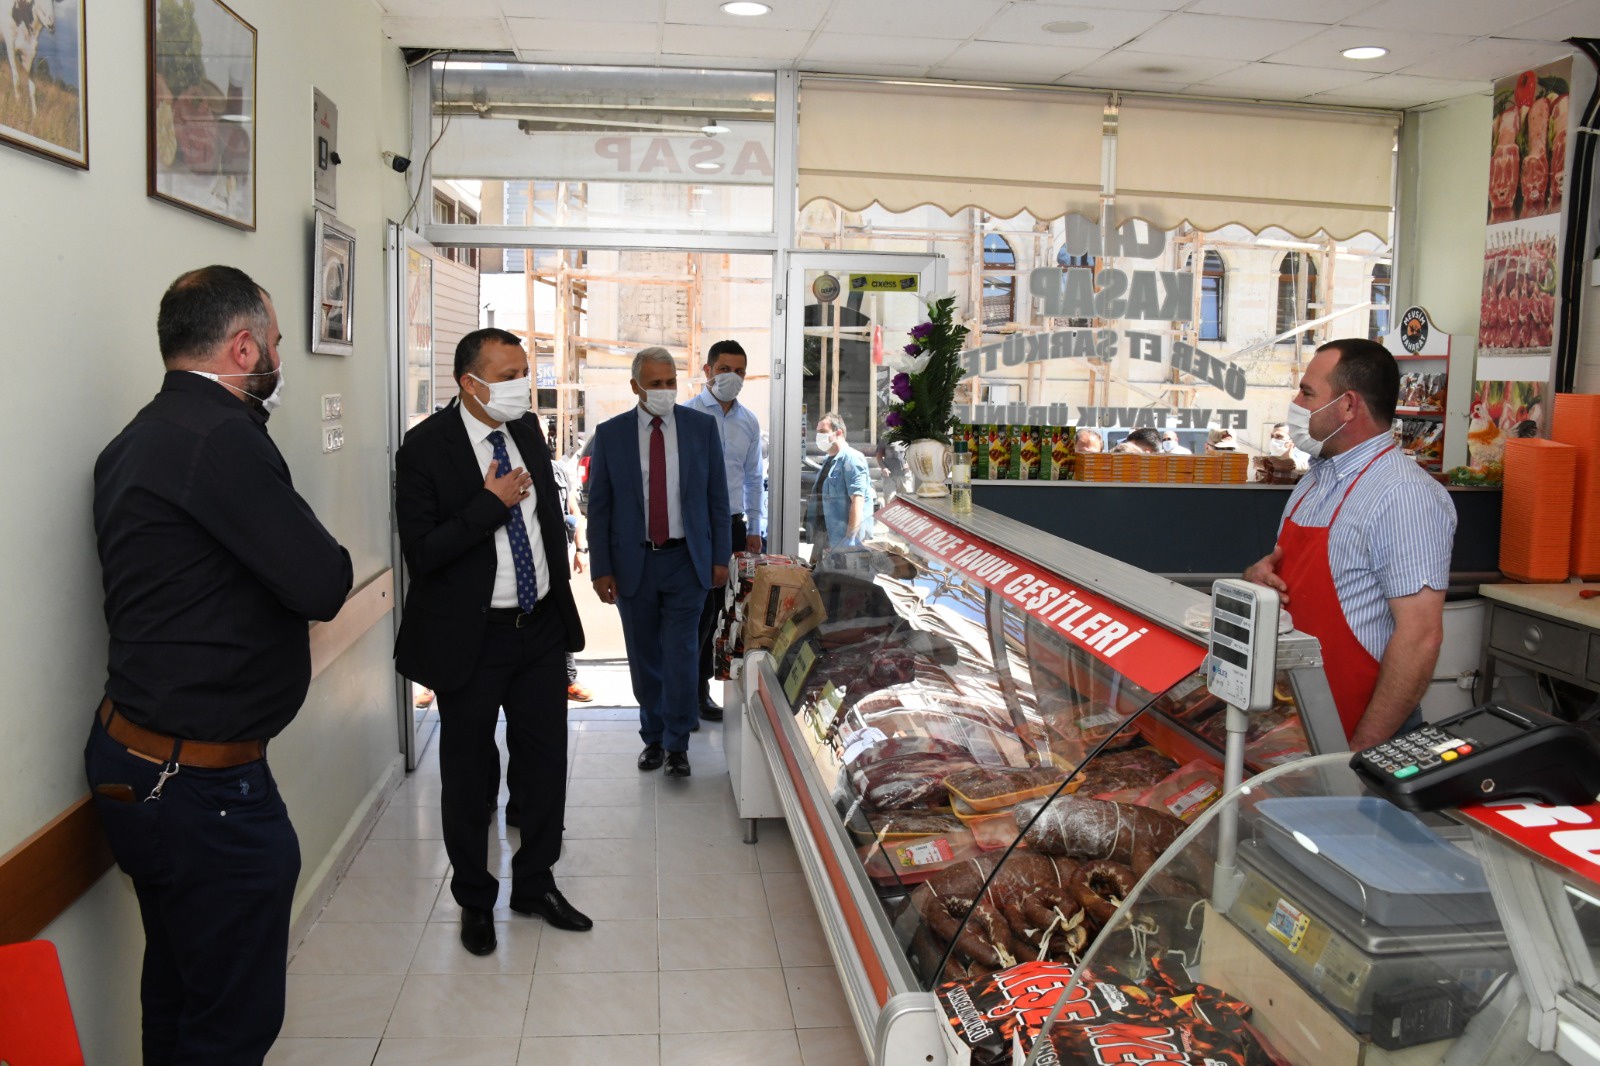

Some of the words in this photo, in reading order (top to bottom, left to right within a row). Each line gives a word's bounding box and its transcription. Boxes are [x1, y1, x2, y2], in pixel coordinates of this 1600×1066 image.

[871, 280, 897, 289] axess
[881, 504, 933, 539] GÜNLÜK
[919, 527, 965, 557] TAZE
[949, 543, 1019, 585] TAVUK
[991, 960, 1102, 1026] MEŞE
